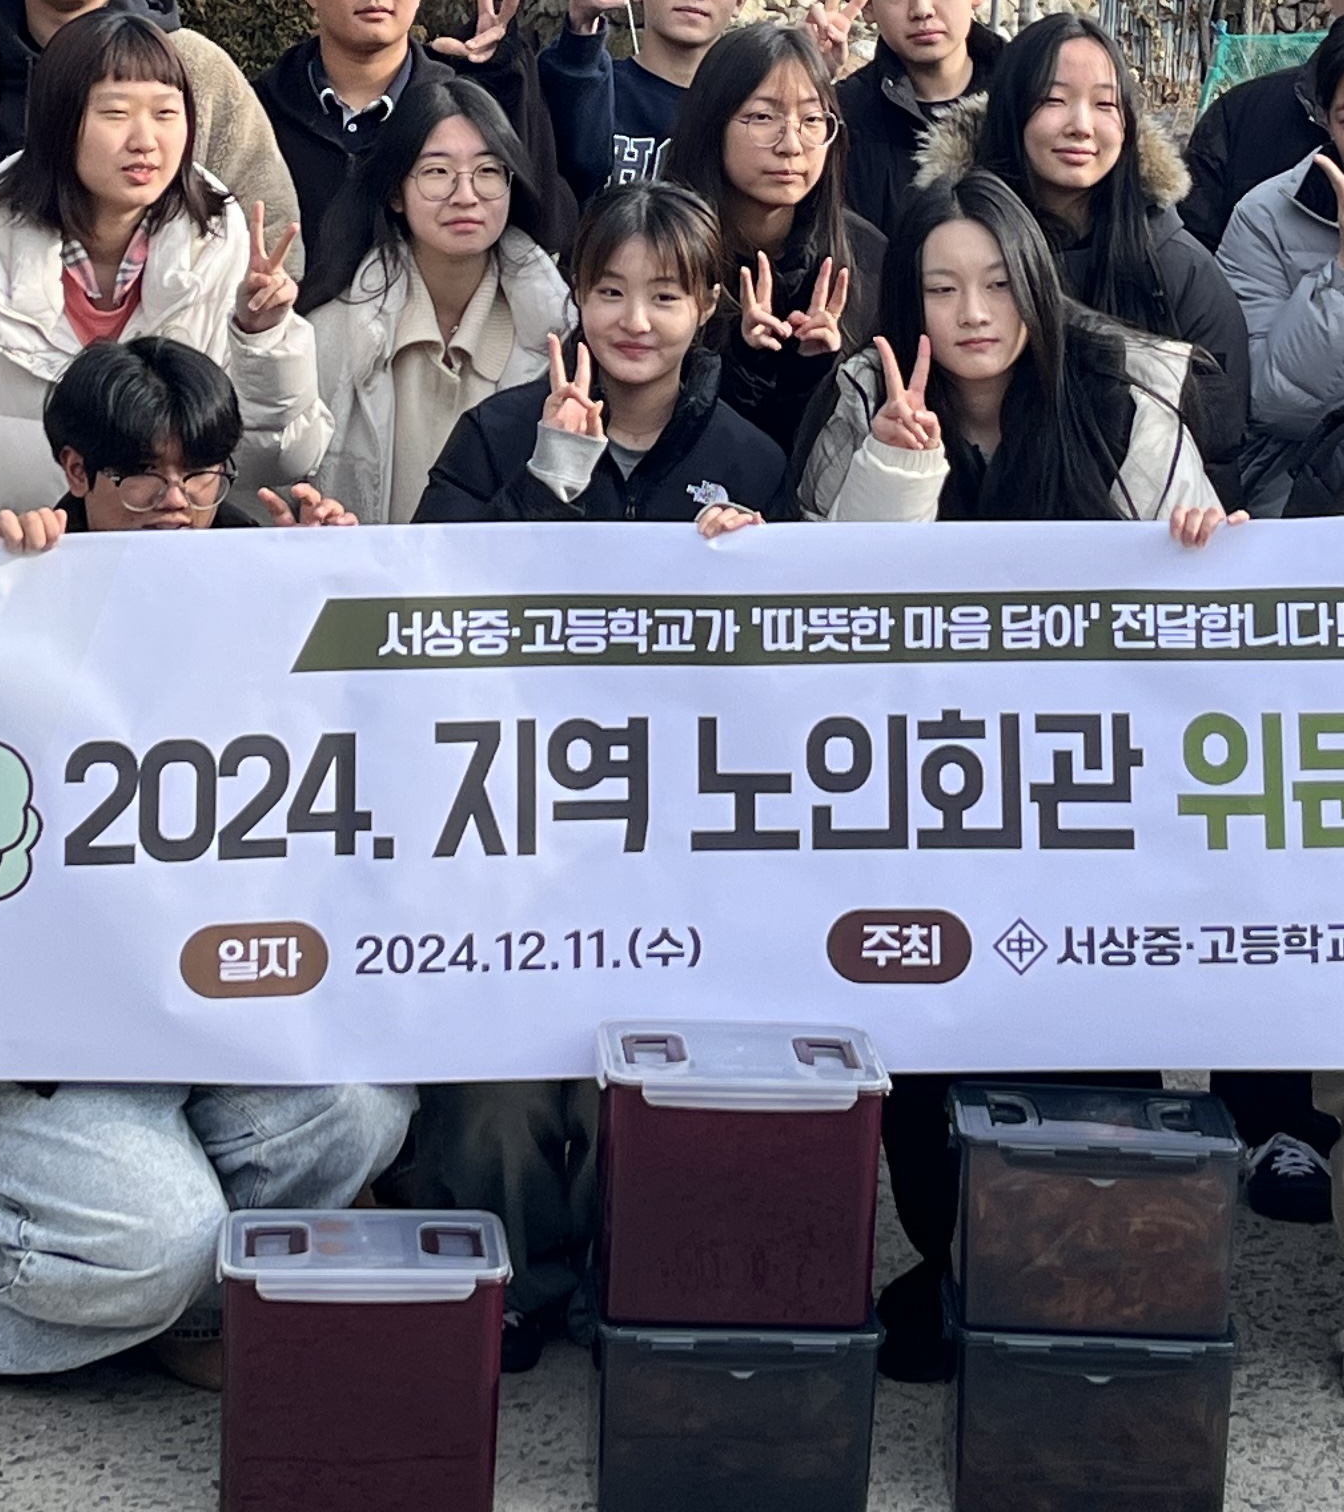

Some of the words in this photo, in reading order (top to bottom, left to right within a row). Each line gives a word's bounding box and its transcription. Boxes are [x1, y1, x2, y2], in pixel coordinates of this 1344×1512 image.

[751, 605, 894, 653] '따뜻한
[903, 605, 991, 650] 마음
[1001, 602, 1100, 650] 담아'
[64, 733, 395, 866] 2024.
[431, 716, 649, 858] 지역
[691, 708, 1144, 852] 노인회관
[217, 935, 303, 982] 일자
[355, 926, 702, 975] 2024.12.11.(수)
[861, 924, 941, 968] 주최
